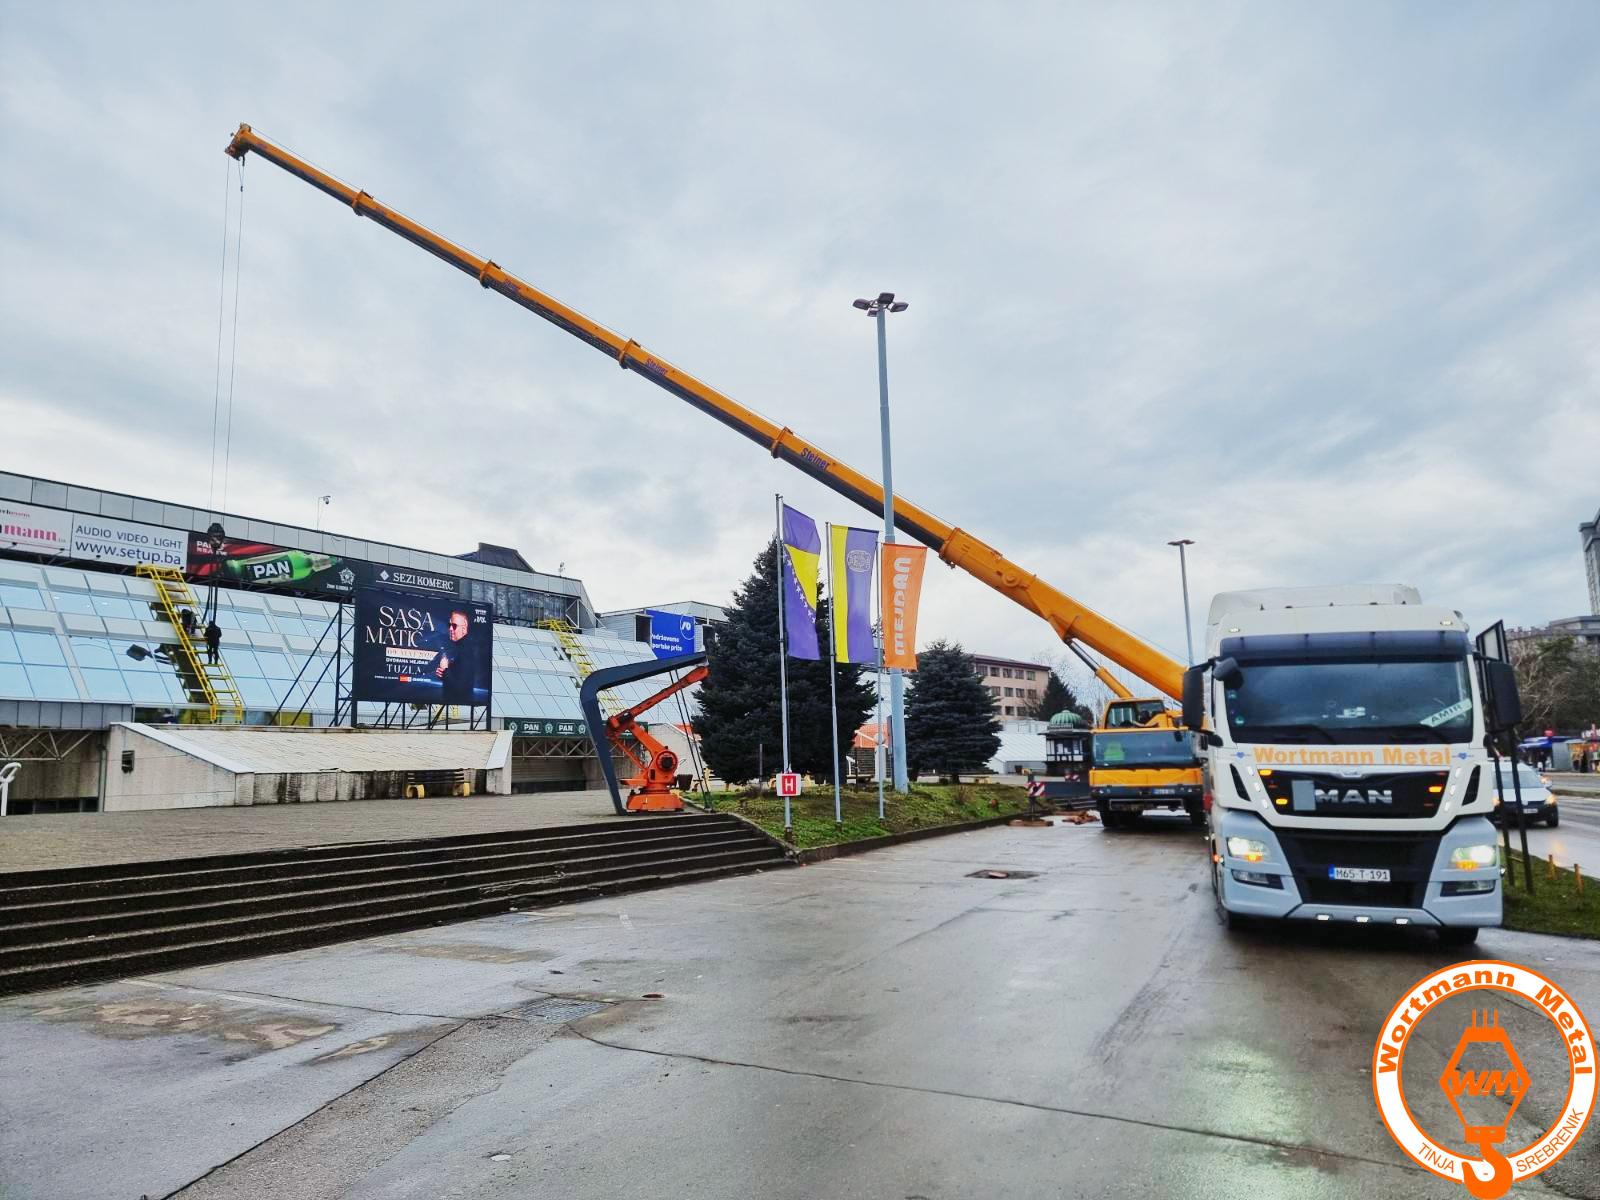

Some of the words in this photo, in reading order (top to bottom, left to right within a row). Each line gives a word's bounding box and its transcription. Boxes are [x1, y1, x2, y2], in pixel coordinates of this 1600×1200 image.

[801, 447, 829, 471] Steiner
[75, 525, 112, 538] AUDIO
[116, 530, 149, 544] VIDEO
[153, 537, 184, 550] LIGHT
[75, 541, 182, 565] www.setup.ba
[253, 560, 291, 578] PAN
[393, 572, 416, 585] SEZI
[417, 576, 454, 591] KOMERC
[523, 723, 540, 732] PAN
[558, 724, 574, 732] PAN
[1253, 746, 1375, 765] Wortmann
[1383, 745, 1451, 766] Metal
[1315, 789, 1393, 804] MAN
